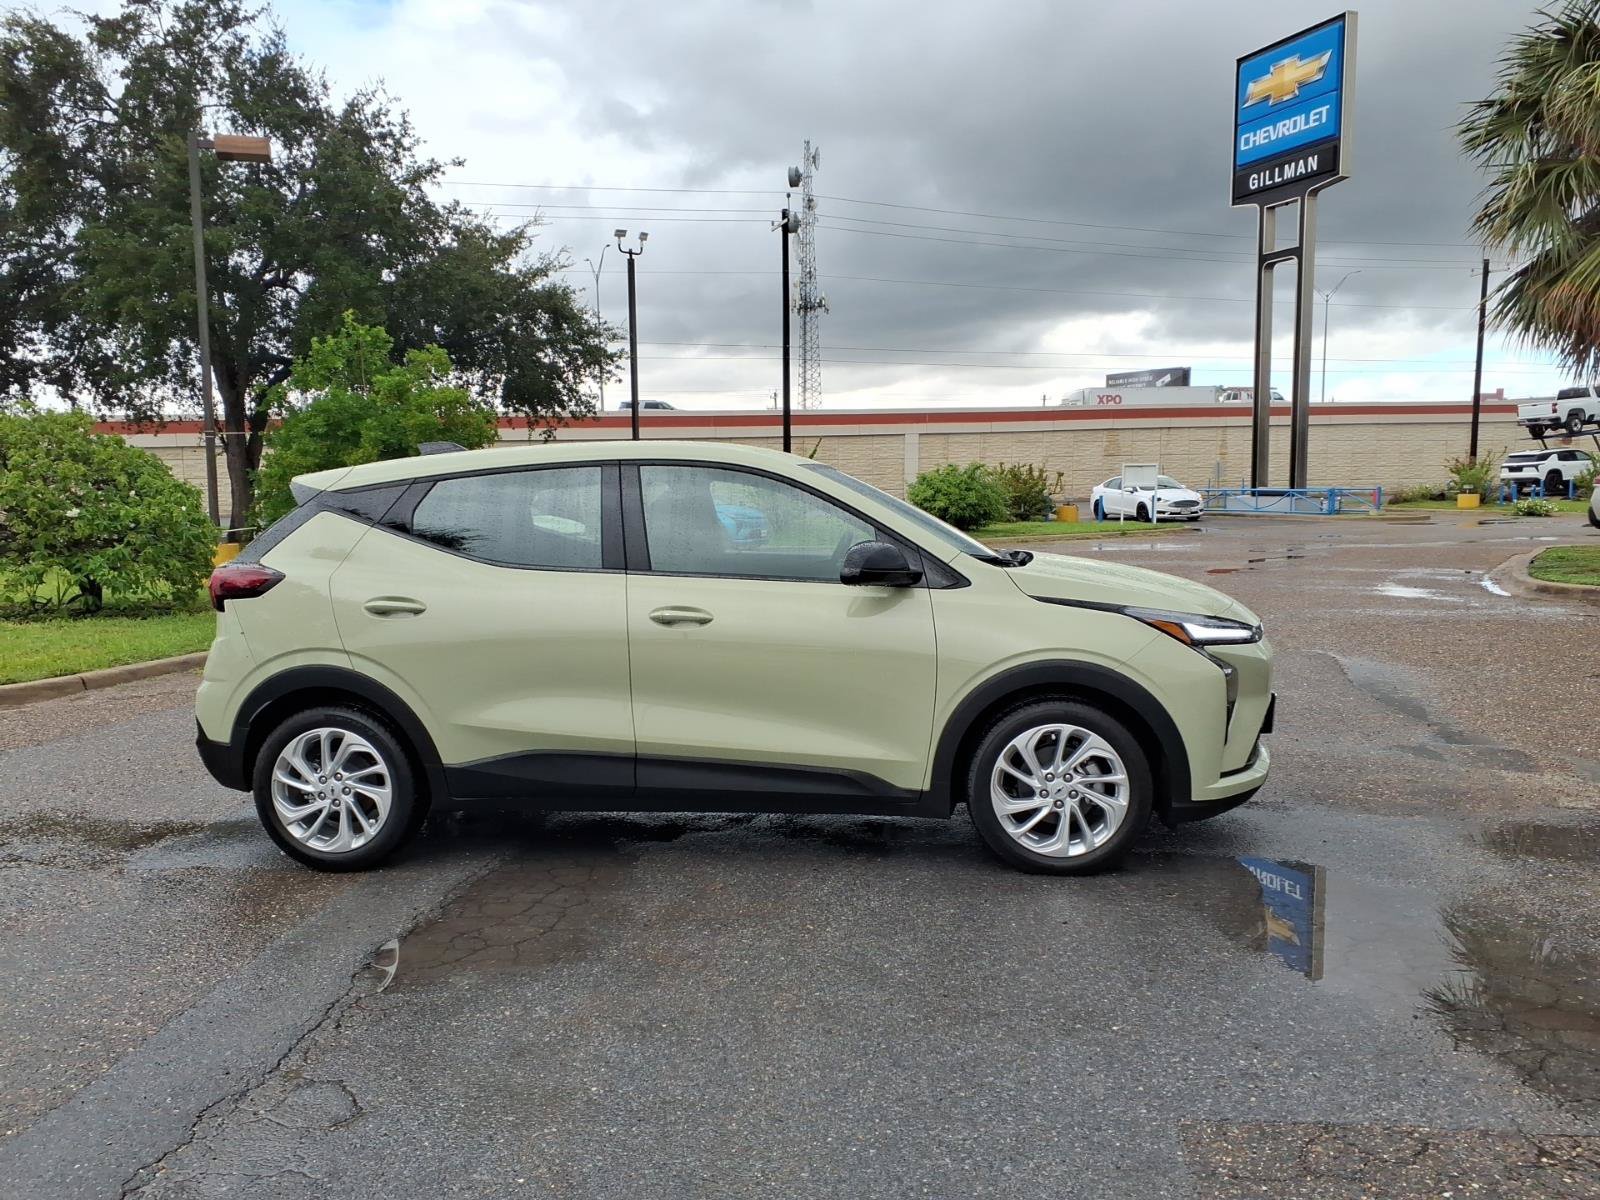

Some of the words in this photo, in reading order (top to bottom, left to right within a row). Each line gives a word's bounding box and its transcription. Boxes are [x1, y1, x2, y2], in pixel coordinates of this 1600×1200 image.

[1240, 105, 1330, 151] CHEVROLET
[1249, 155, 1318, 190] GILLMAN
[1097, 395, 1122, 405] XPO
